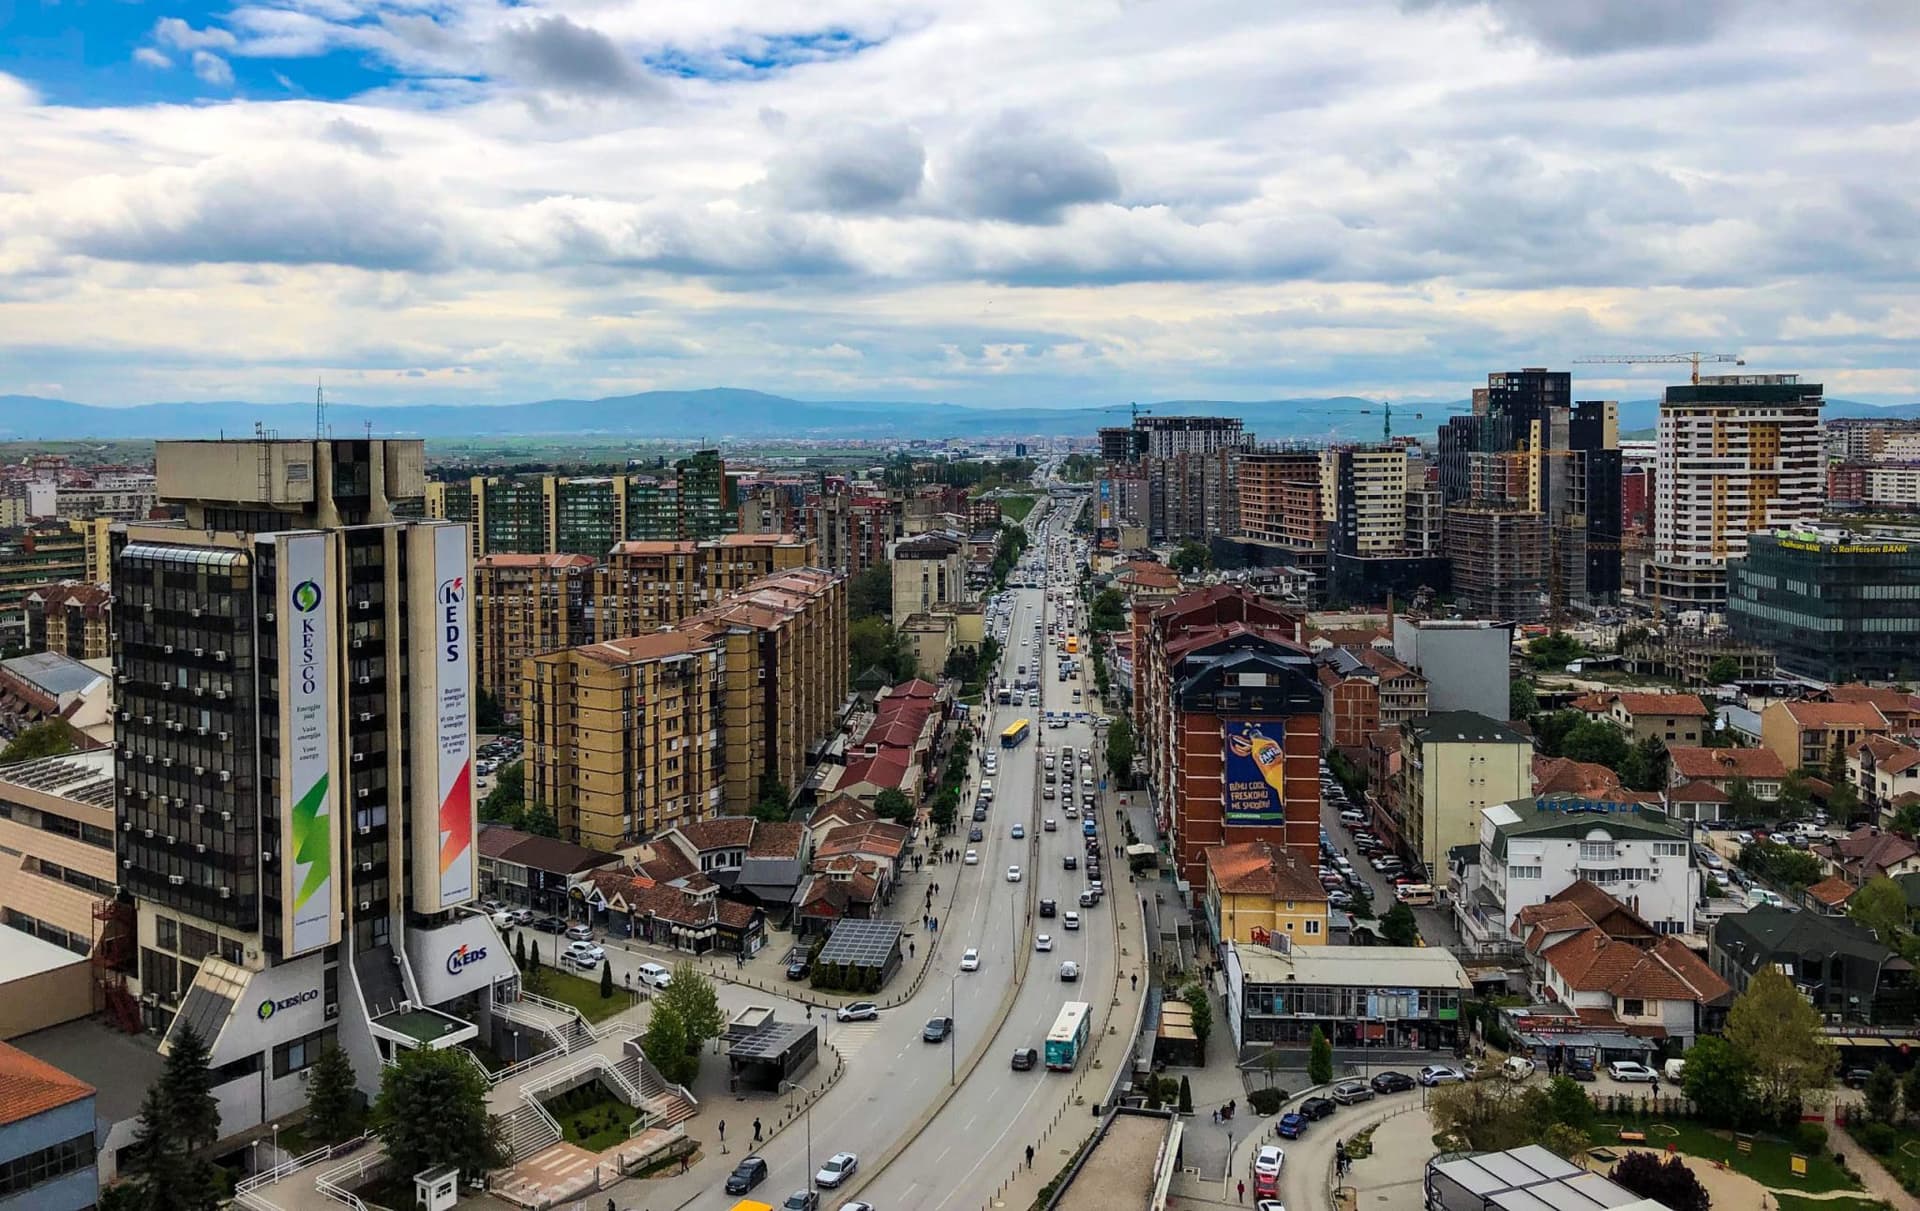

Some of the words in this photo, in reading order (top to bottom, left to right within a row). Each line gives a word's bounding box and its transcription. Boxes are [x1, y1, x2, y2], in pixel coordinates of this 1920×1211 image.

[1839, 544, 1881, 553] Raiffeisen
[1882, 544, 1909, 553] BANK
[445, 578, 463, 662] KEDS
[452, 944, 488, 970] KEDS
